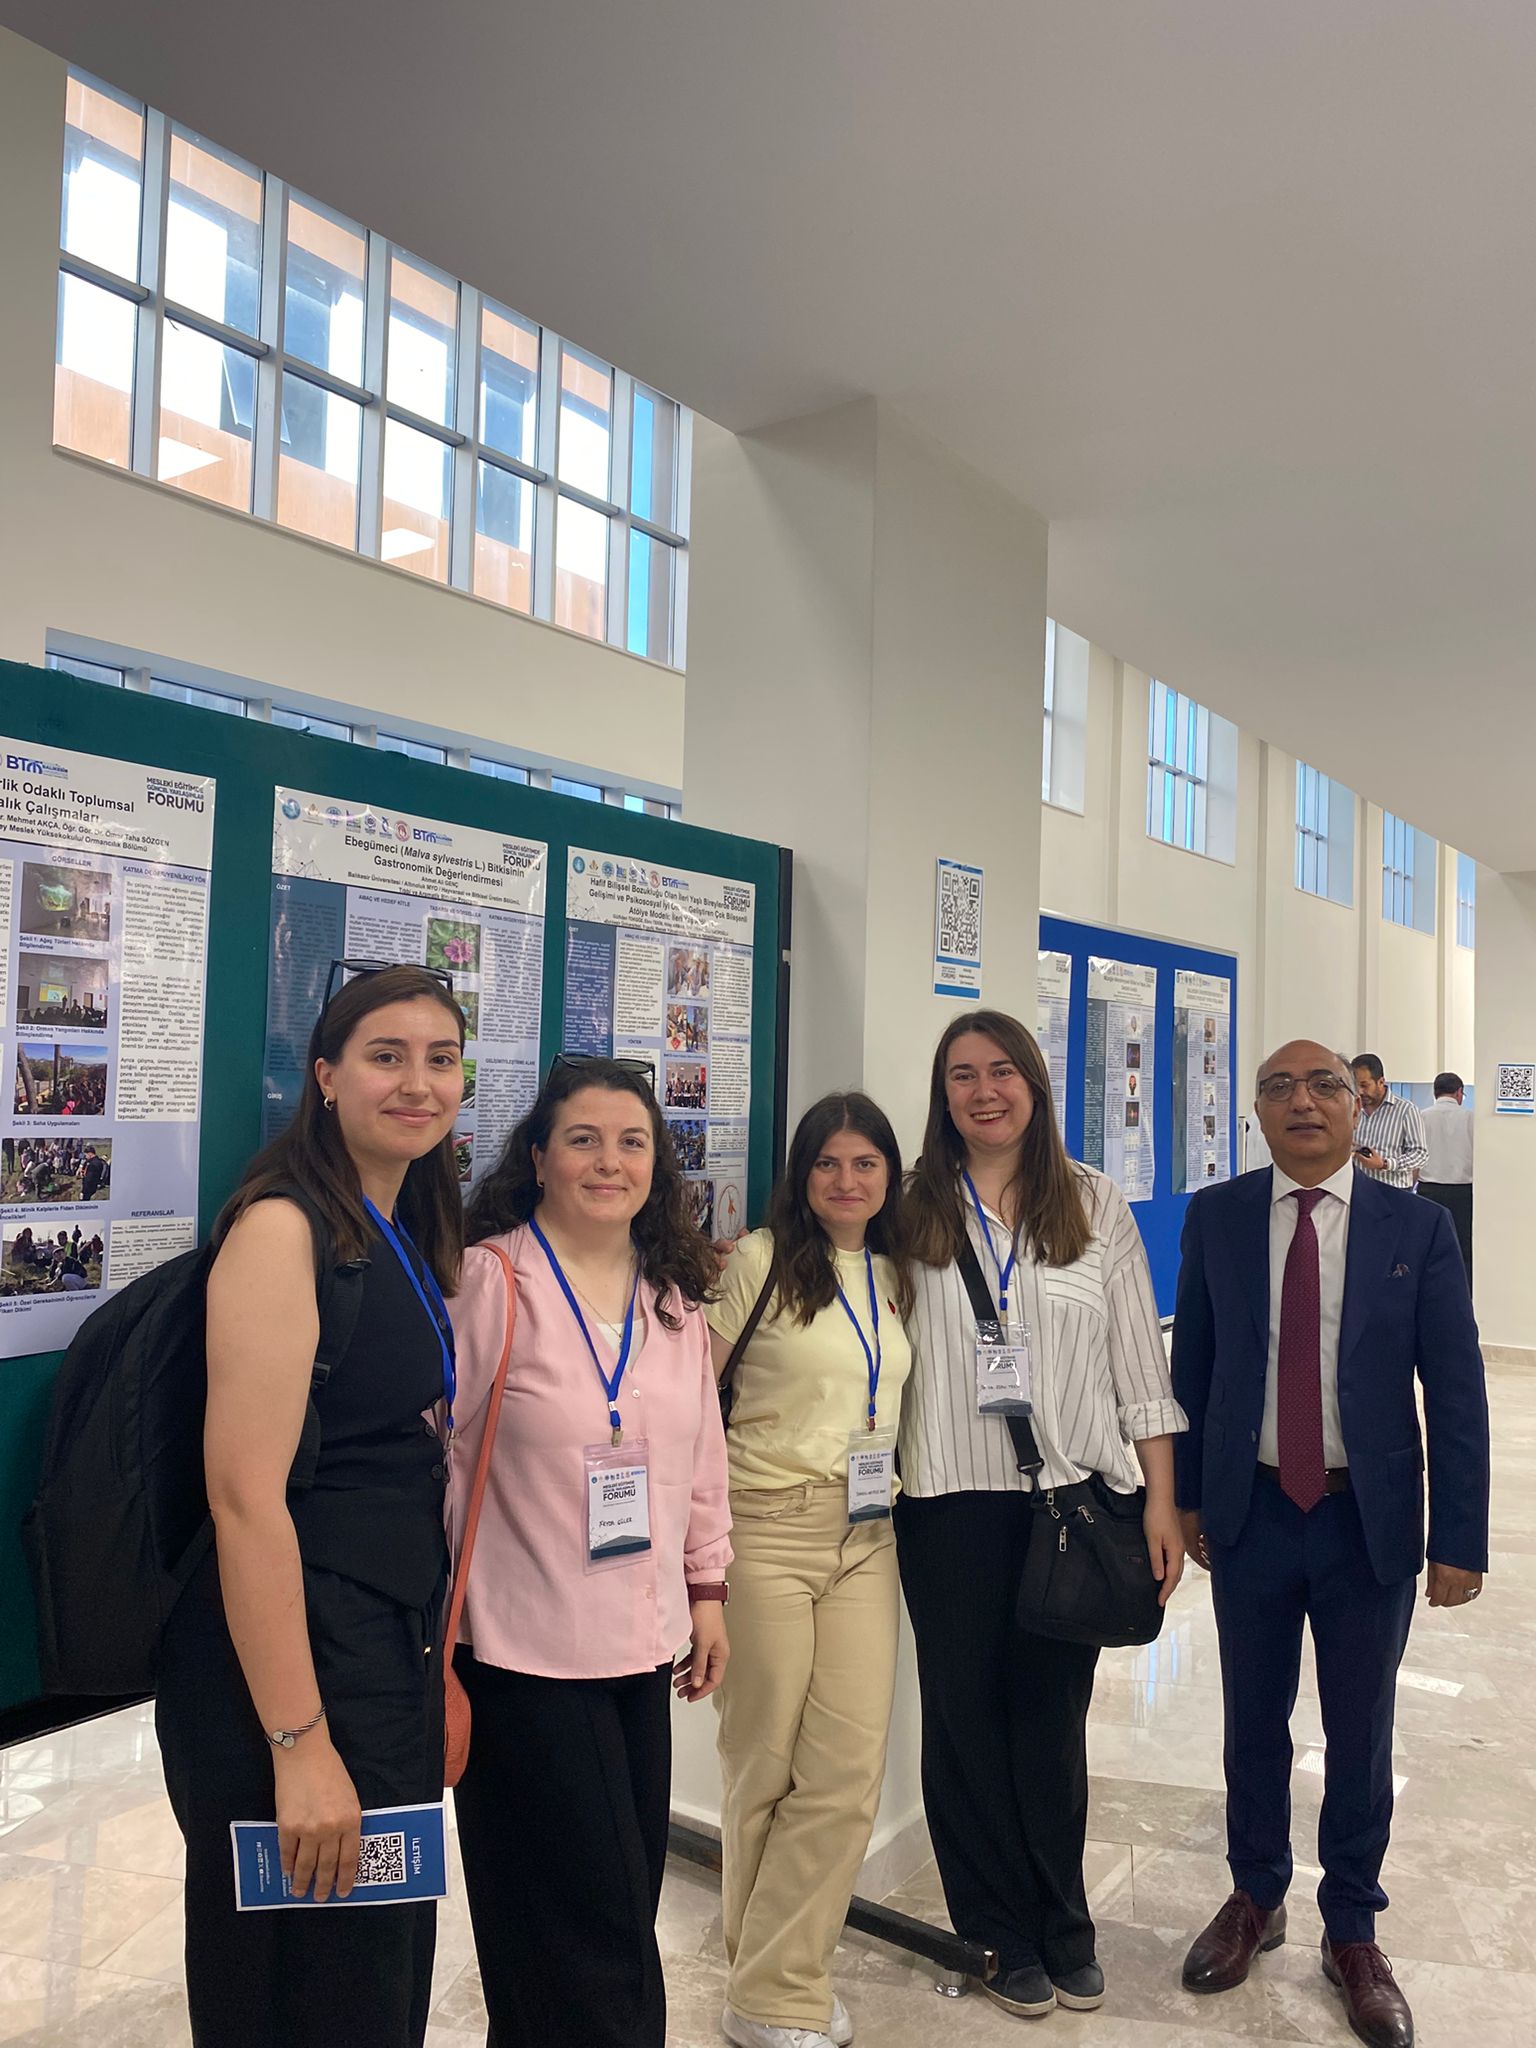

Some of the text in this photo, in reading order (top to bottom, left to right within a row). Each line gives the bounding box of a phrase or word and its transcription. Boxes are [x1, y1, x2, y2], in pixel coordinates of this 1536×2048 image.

[146, 777, 174, 788] MESLEKİ
[23, 782, 65, 800] Odaklı
[69, 790, 134, 812] Toplumsal
[147, 791, 204, 813] FORUMU
[7, 815, 35, 826] Mehmet
[26, 801, 99, 822] Çalışmaları
[9, 824, 34, 834] Meslek
[345, 835, 524, 878] Ebegümeci (Malva sylvestris L.) Bitkisinin
[374, 856, 503, 887] Gastronomik Değerlendirmesi
[276, 883, 291, 891] ÖZET
[589, 889, 615, 900] Gelişimi
[626, 895, 662, 908] Psikososyal
[629, 907, 648, 917] Atölye
[603, 1489, 636, 1501] FORUMU
[413, 1837, 421, 1875] İLETİŞİM
